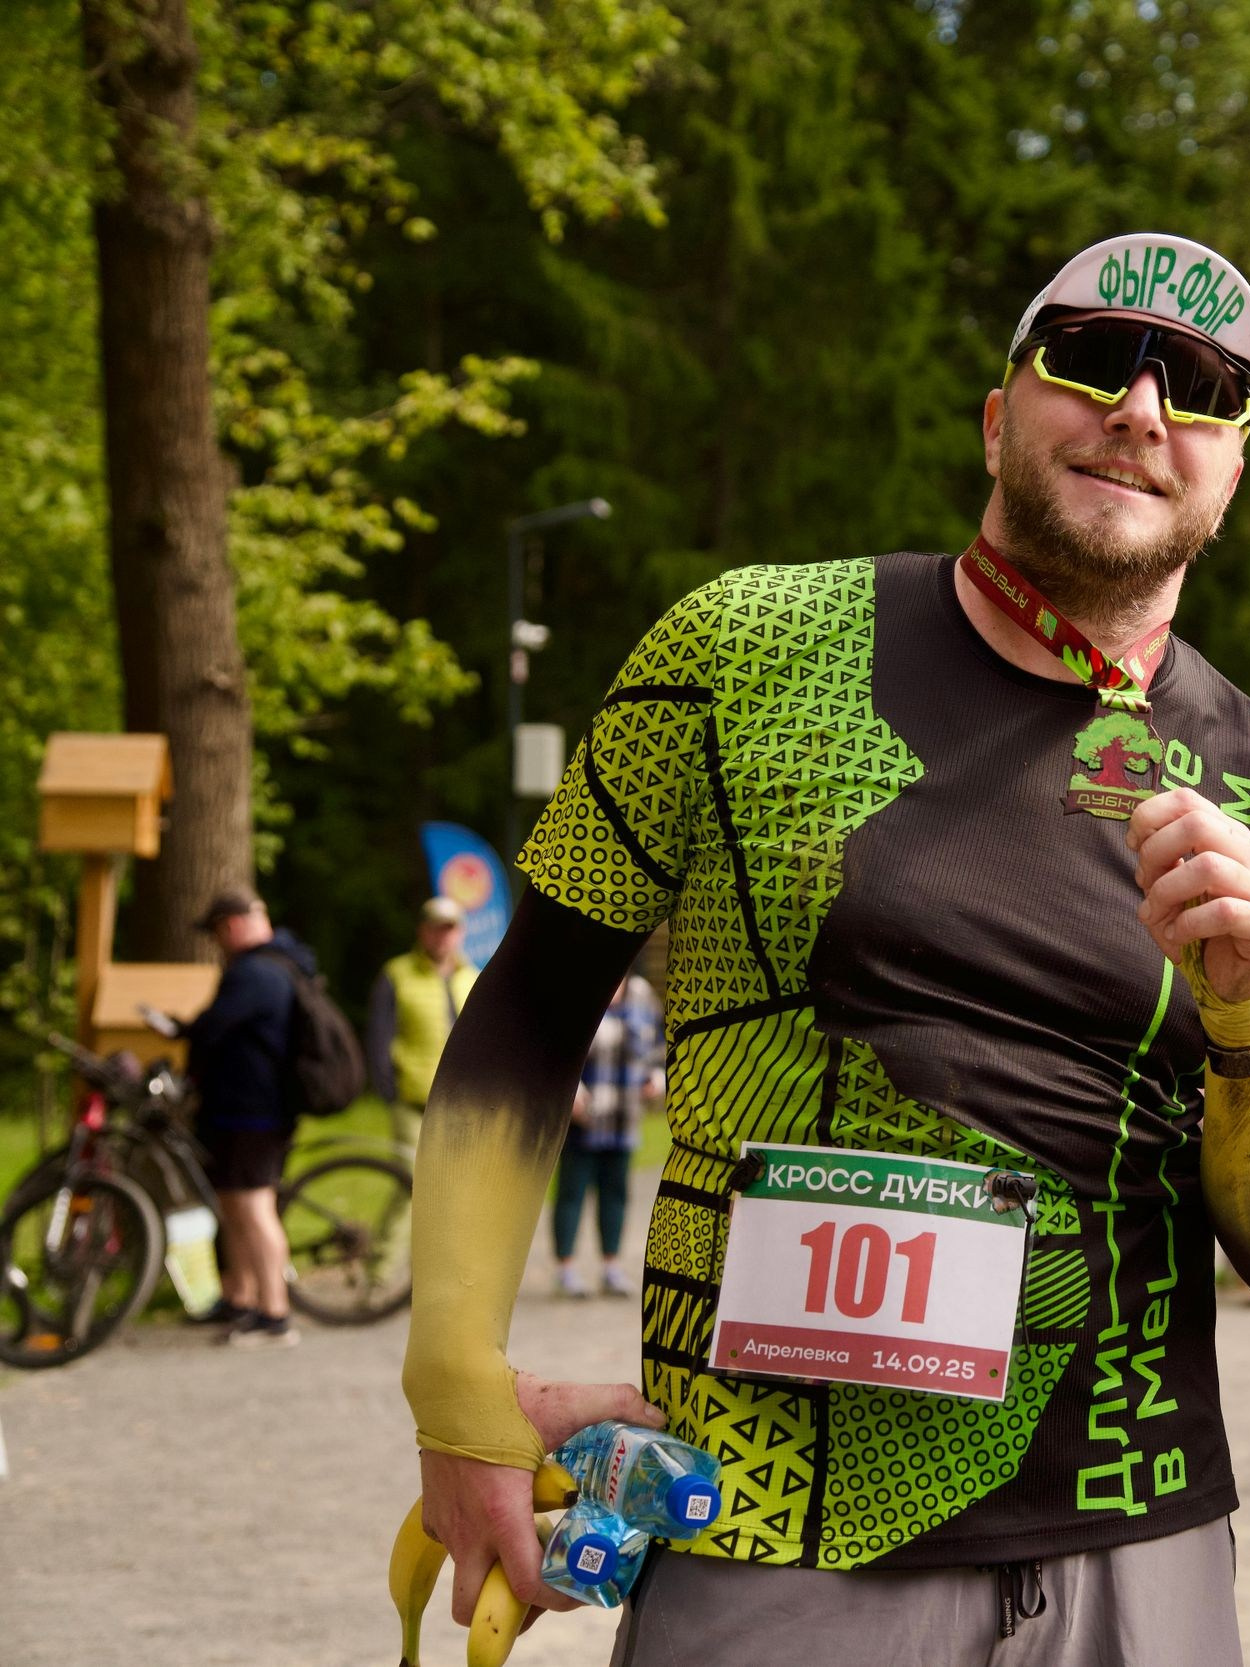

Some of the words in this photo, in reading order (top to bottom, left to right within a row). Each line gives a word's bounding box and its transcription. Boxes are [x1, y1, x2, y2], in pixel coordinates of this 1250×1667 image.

[1099, 247, 1244, 336] ФЫР-ФЫР
[767, 1165, 874, 1194] КРОСС
[800, 1221, 937, 1324] 101
[743, 1338, 850, 1364] Апрелевка
[872, 1351, 976, 1380] 14.09.25
